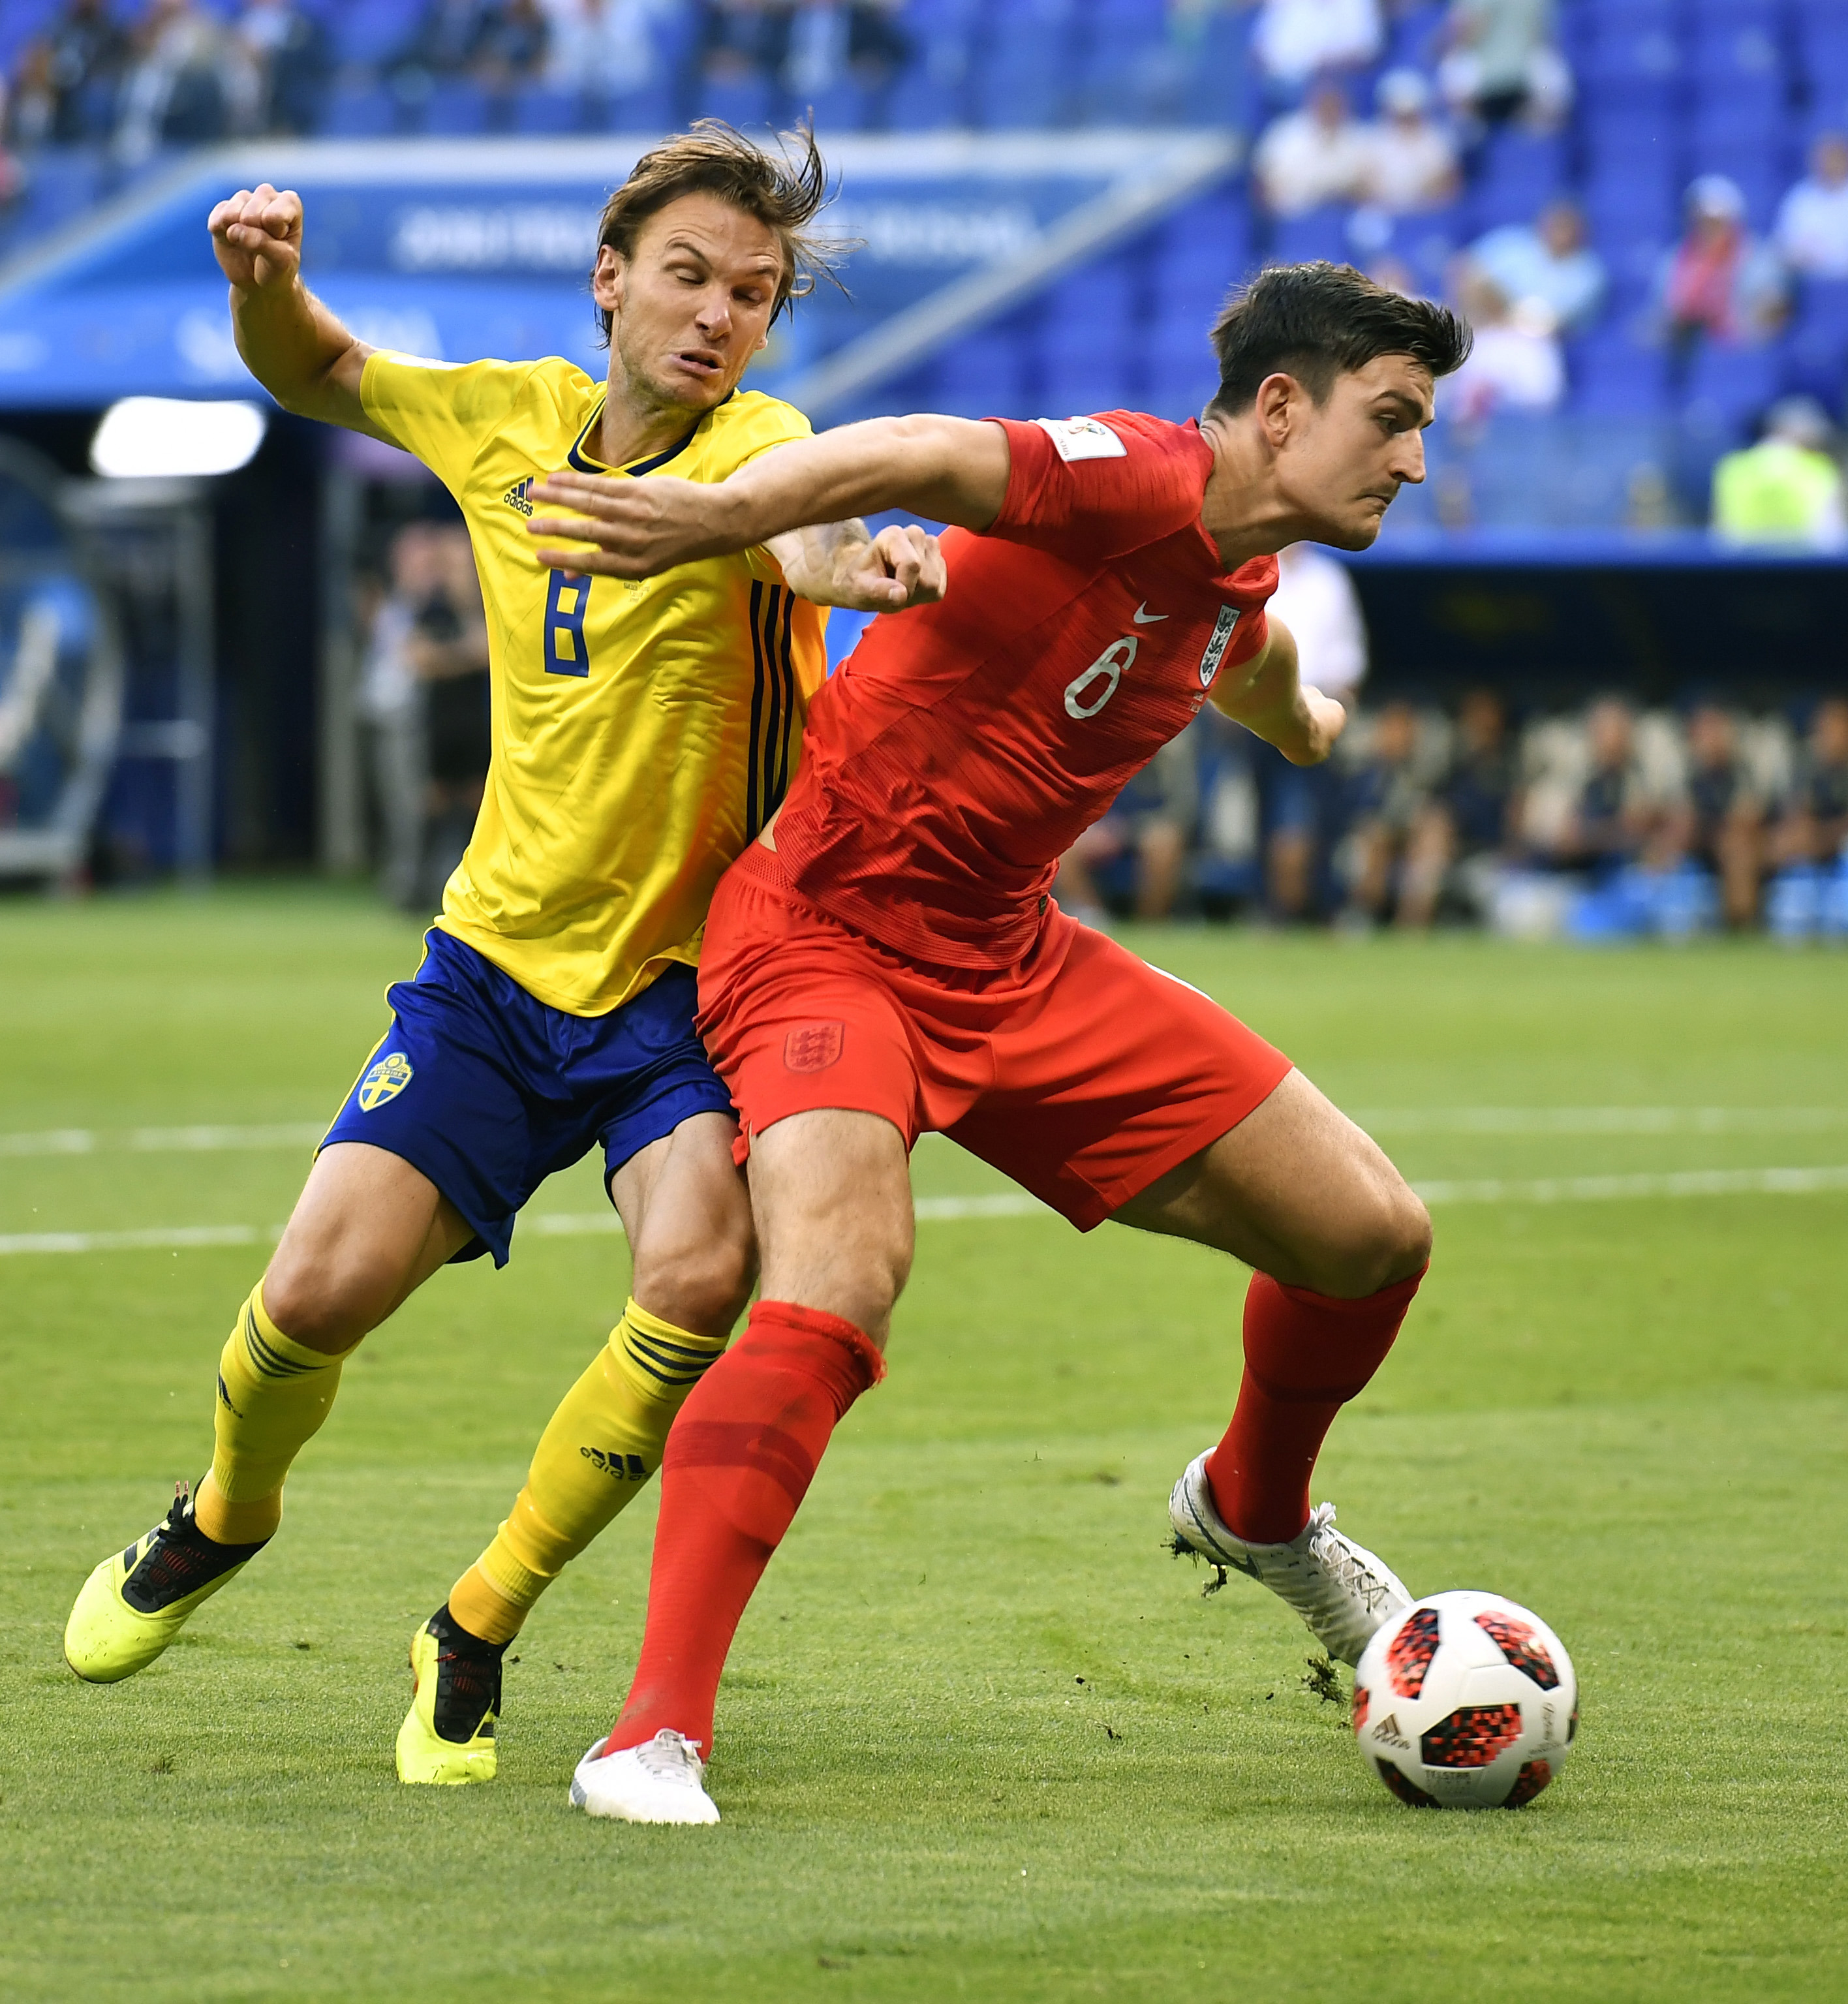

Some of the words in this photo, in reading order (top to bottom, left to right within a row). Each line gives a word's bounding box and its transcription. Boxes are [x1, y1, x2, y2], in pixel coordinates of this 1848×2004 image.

[503, 493, 534, 517] adidas
[544, 568, 593, 678] 8
[1064, 636, 1138, 719] 6
